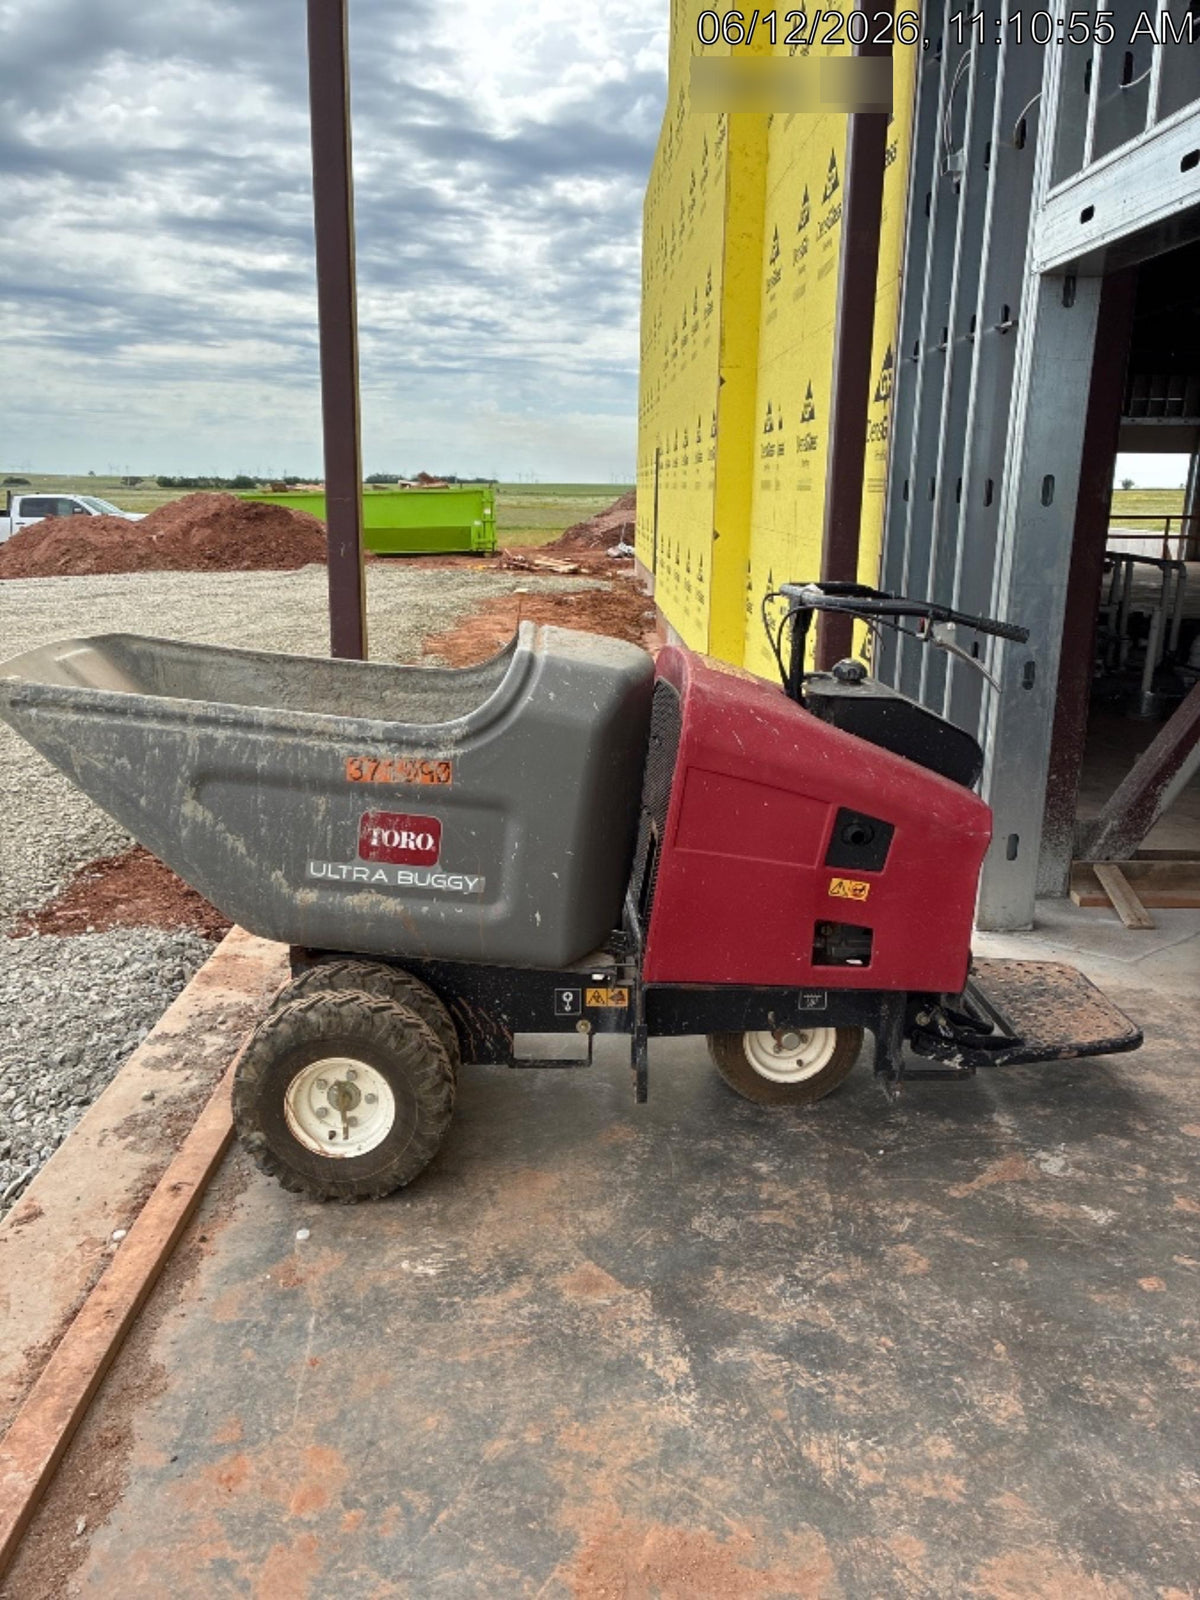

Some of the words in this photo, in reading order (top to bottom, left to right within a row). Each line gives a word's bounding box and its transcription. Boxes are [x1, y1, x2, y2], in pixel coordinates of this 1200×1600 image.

[369, 827, 435, 851] TORO
[309, 861, 389, 884] ULTRA
[397, 870, 479, 895] BUGGY
